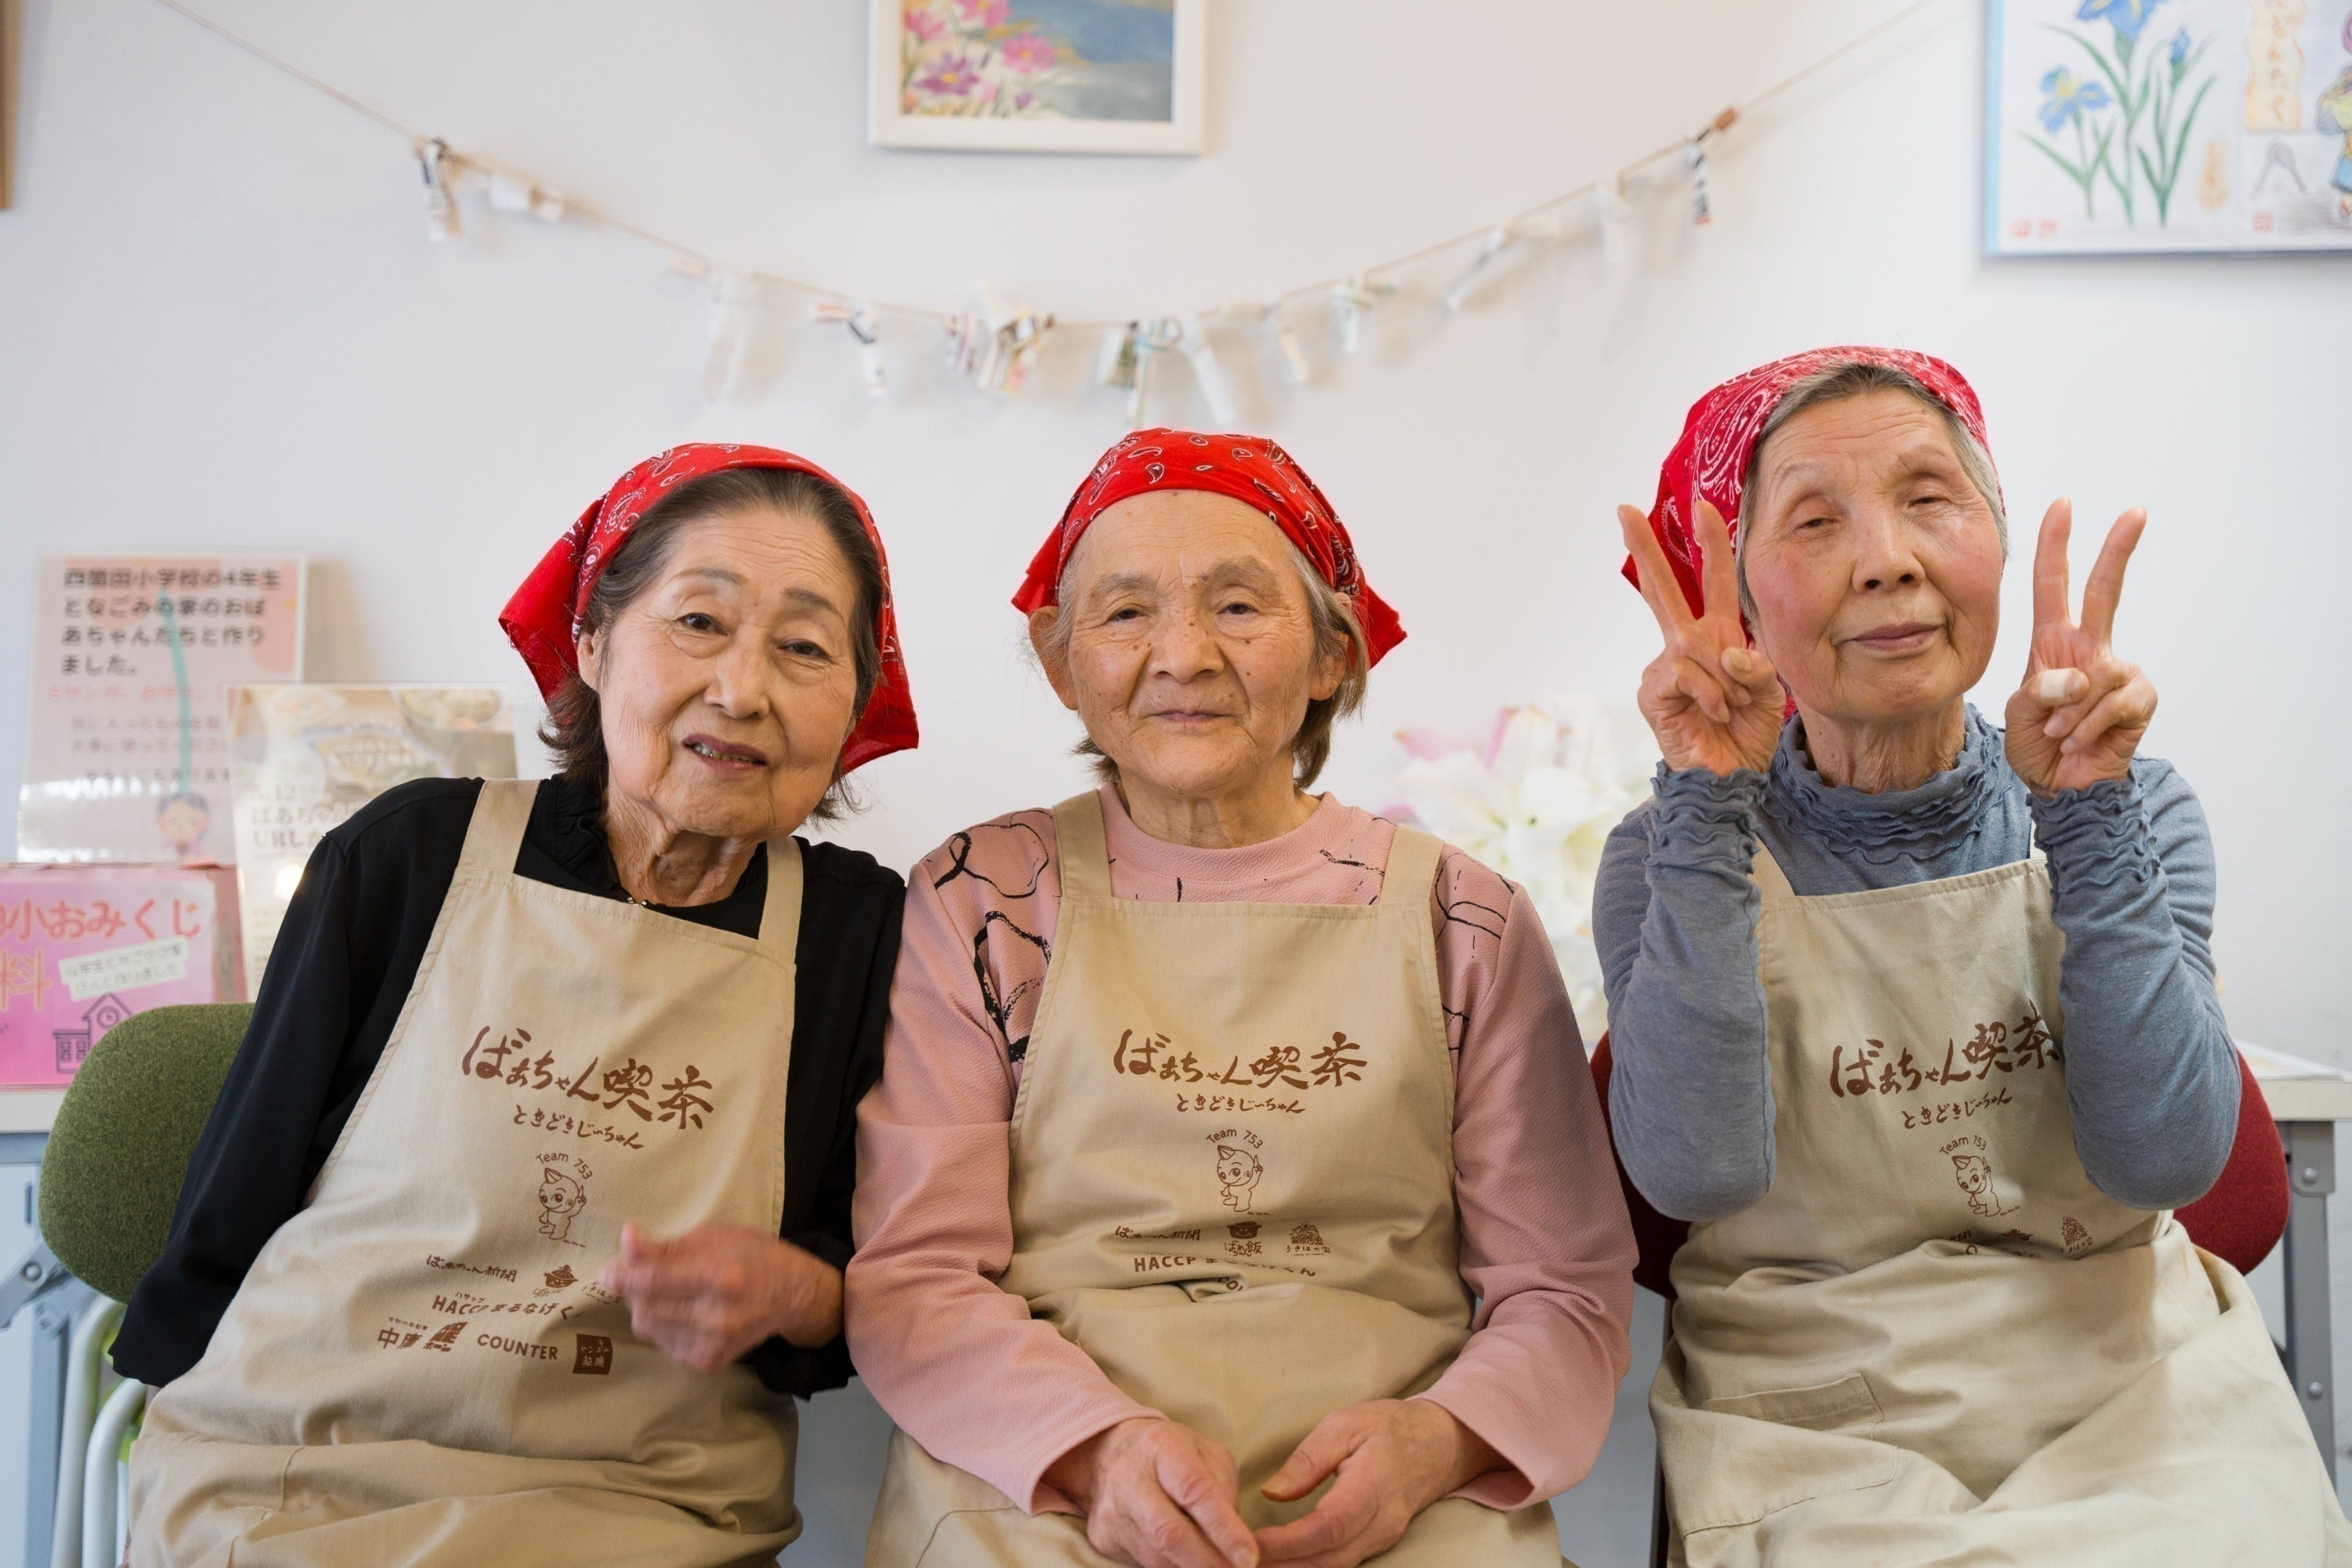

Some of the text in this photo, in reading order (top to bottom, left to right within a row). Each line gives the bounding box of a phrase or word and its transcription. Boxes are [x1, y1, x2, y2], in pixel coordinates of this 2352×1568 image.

[62, 655, 138, 676] ました。
[0, 898, 201, 940] 小おみくじ
[1113, 1029, 1368, 1090] ばあちゃん喫茶
[1829, 998, 2060, 1098] ばあちゃん喫茶
[462, 1025, 715, 1131] ばあちゃん喫茶
[1206, 1129, 1264, 1149] Team 753
[1939, 1134, 1987, 1156] Team 753
[535, 1152, 593, 1181] Team 753
[477, 1333, 558, 1360] COUNTER
